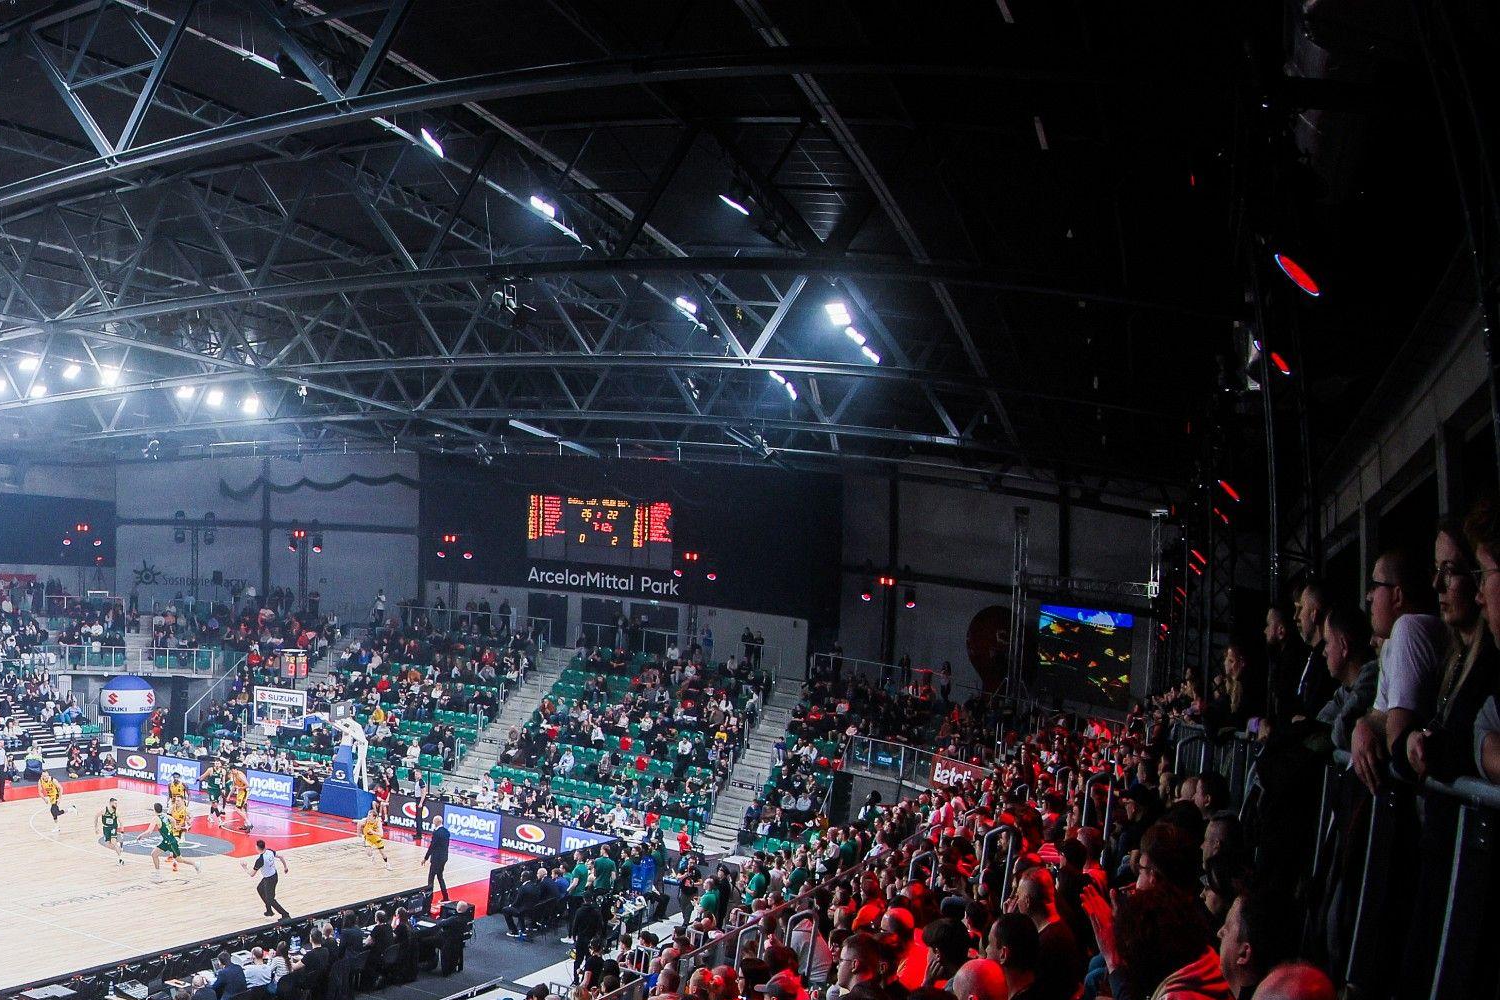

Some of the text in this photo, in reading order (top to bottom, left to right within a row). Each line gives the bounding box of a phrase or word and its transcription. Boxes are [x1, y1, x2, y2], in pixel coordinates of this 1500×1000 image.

[607, 510, 619, 520] 22
[528, 566, 680, 596] ArcelorMittal Park
[288, 664, 296, 676] 9
[267, 693, 298, 703] SUZUKI
[160, 763, 198, 778] molten
[934, 762, 972, 786] Betcli
[249, 778, 291, 794] molten
[446, 811, 497, 833] molten
